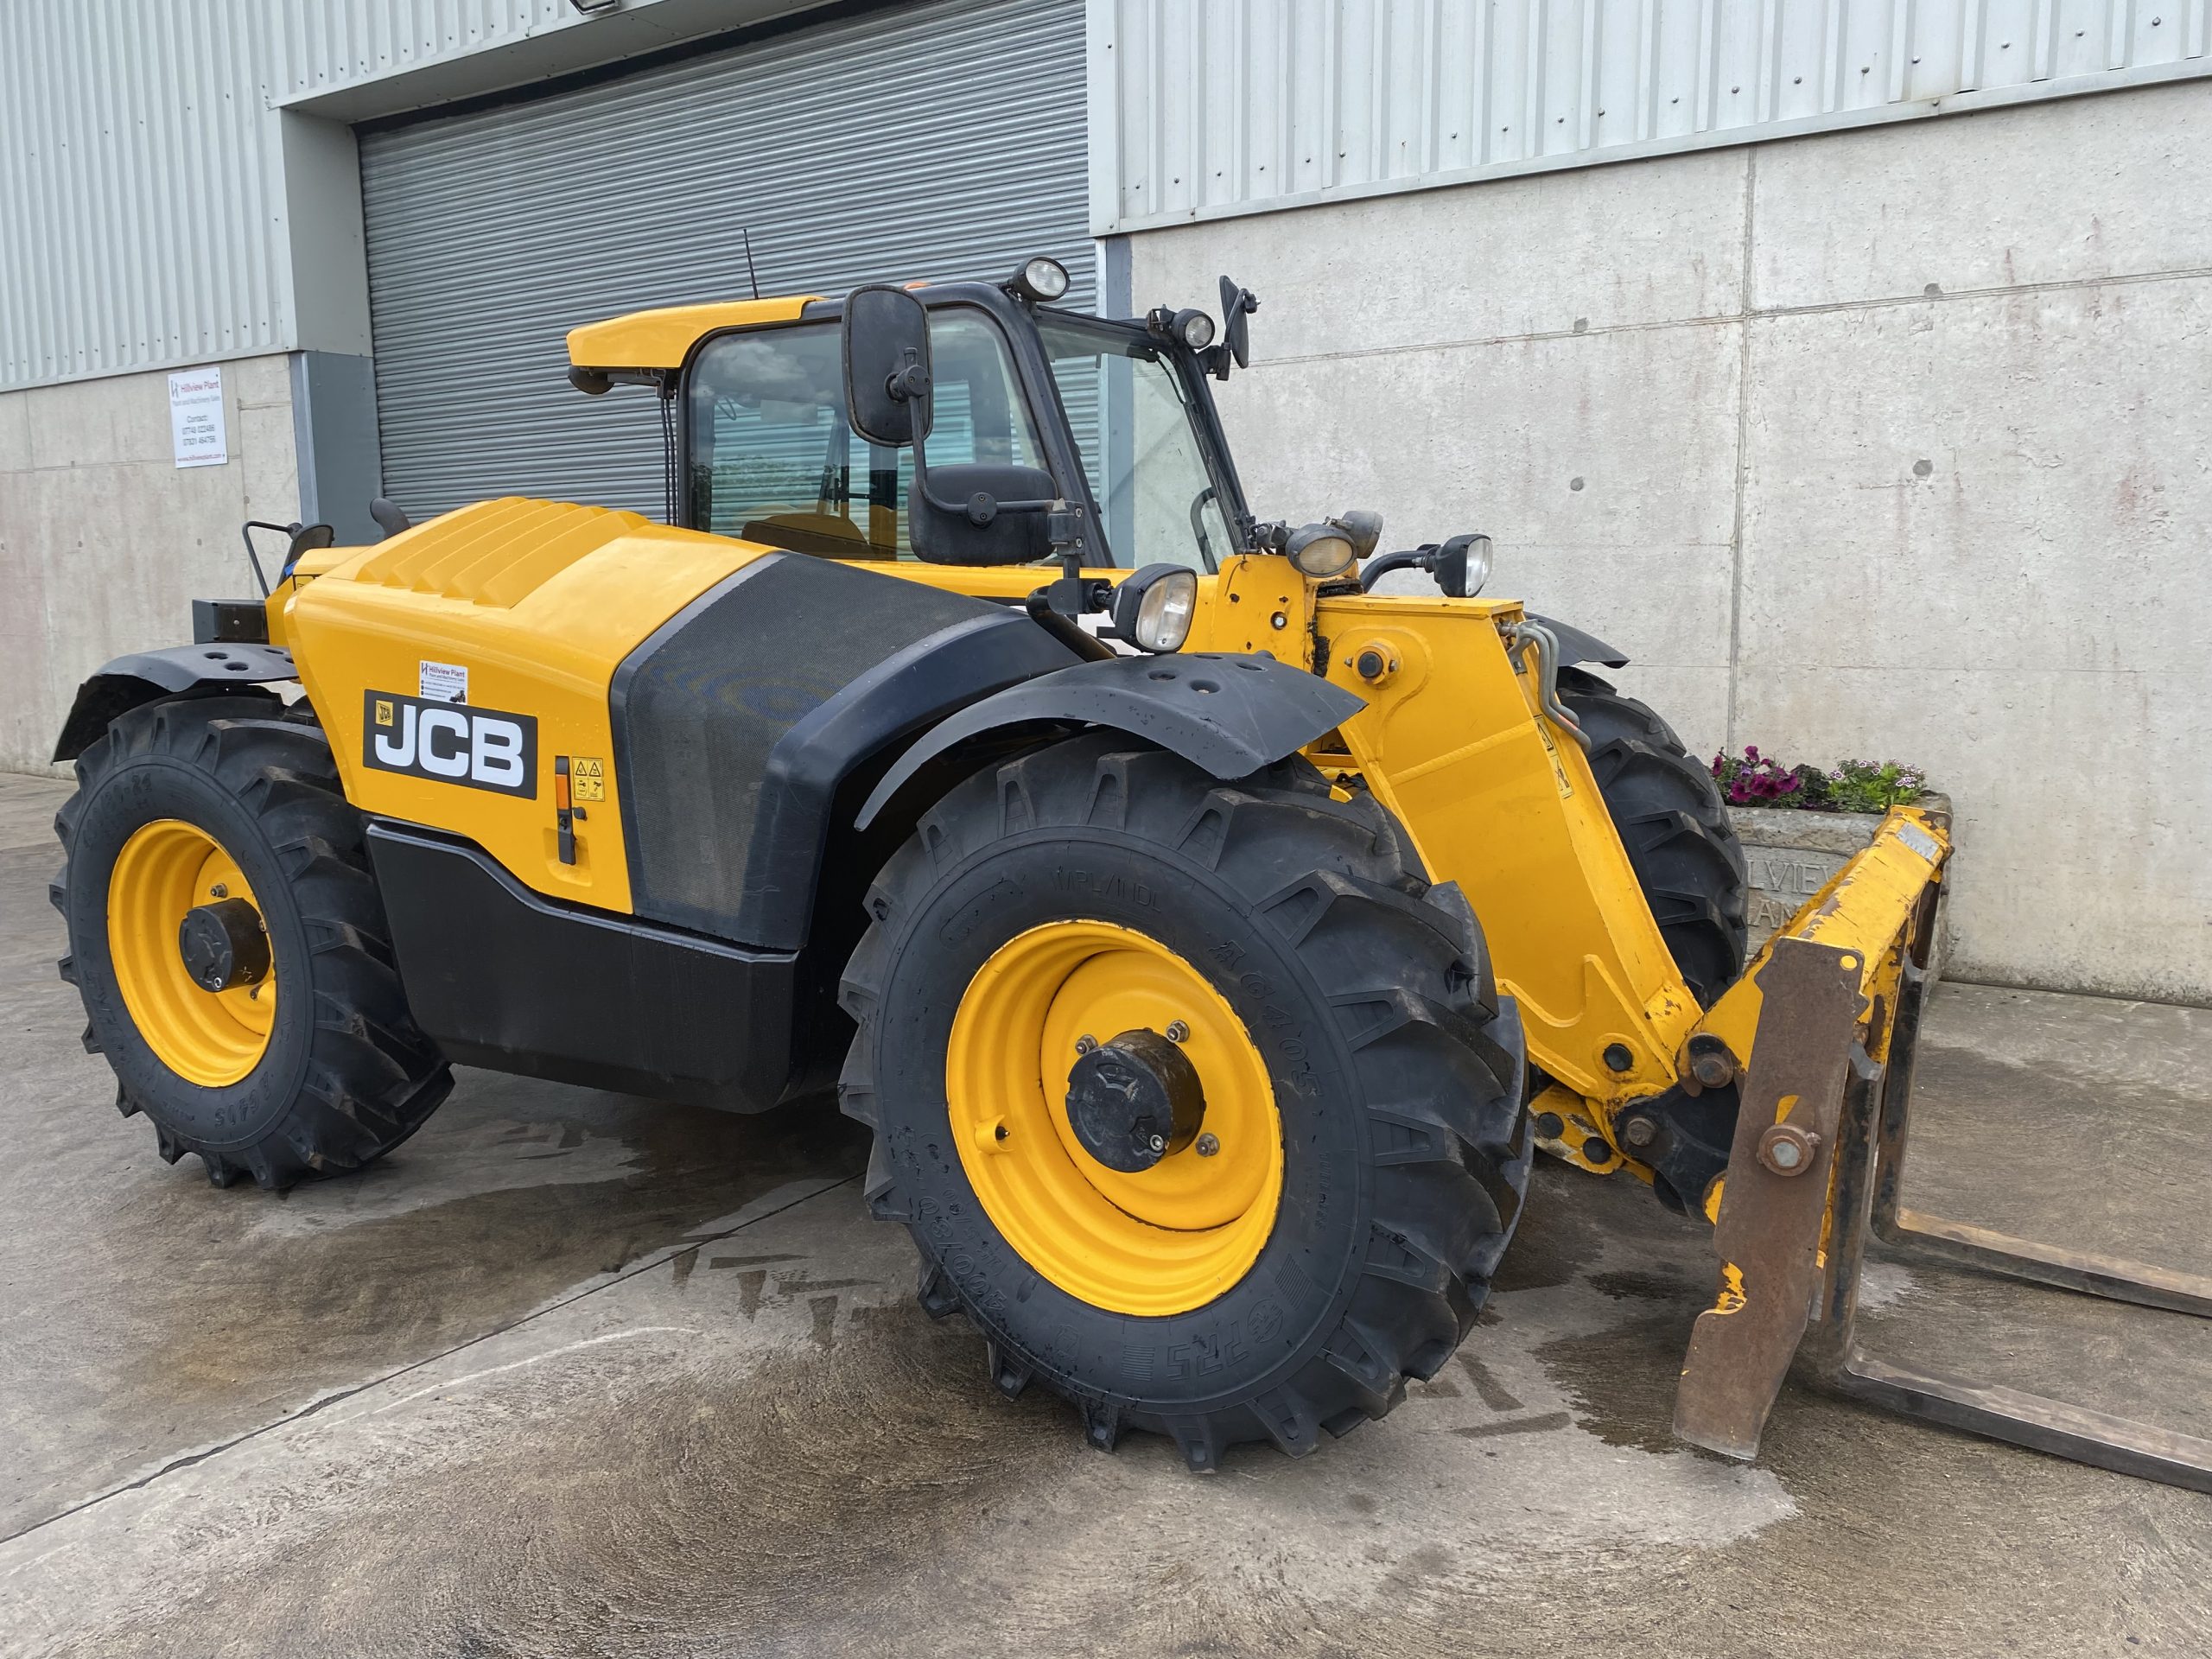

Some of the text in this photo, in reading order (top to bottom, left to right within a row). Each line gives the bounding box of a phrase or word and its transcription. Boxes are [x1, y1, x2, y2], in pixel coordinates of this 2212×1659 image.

[181, 380, 219, 393] Hillview Plant
[429, 665, 465, 677] Hillview Plant
[379, 703, 391, 721] JCB
[375, 704, 524, 787] JCB
